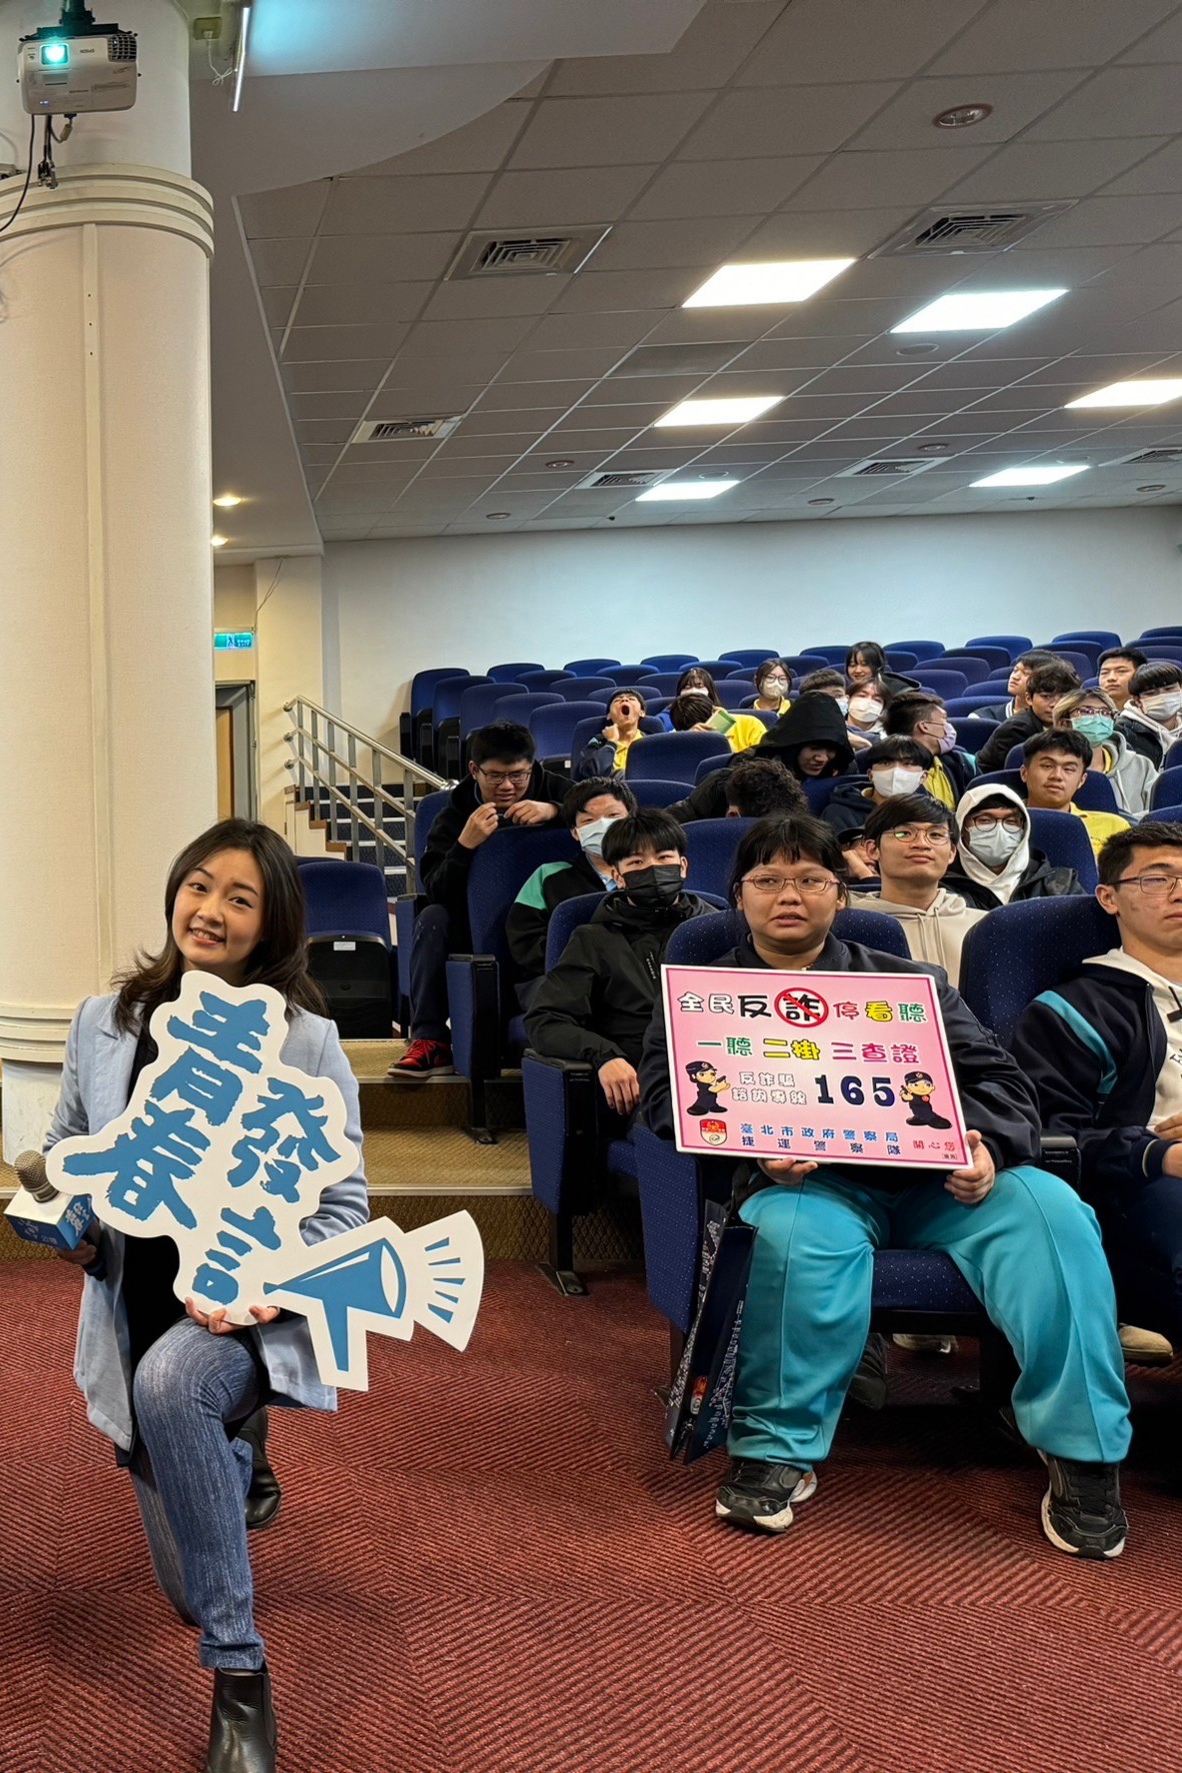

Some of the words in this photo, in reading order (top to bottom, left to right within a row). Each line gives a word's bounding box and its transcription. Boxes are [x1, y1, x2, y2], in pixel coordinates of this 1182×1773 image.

[698, 1036, 753, 1058] 一聽
[762, 1037, 821, 1062] 二掛
[831, 1041, 920, 1065] 三查證
[814, 1074, 896, 1107] 165
[63, 991, 270, 1231] 青春
[740, 1122, 899, 1143] 臺北市政府警察局
[741, 1136, 902, 1156] 捷運警察隊
